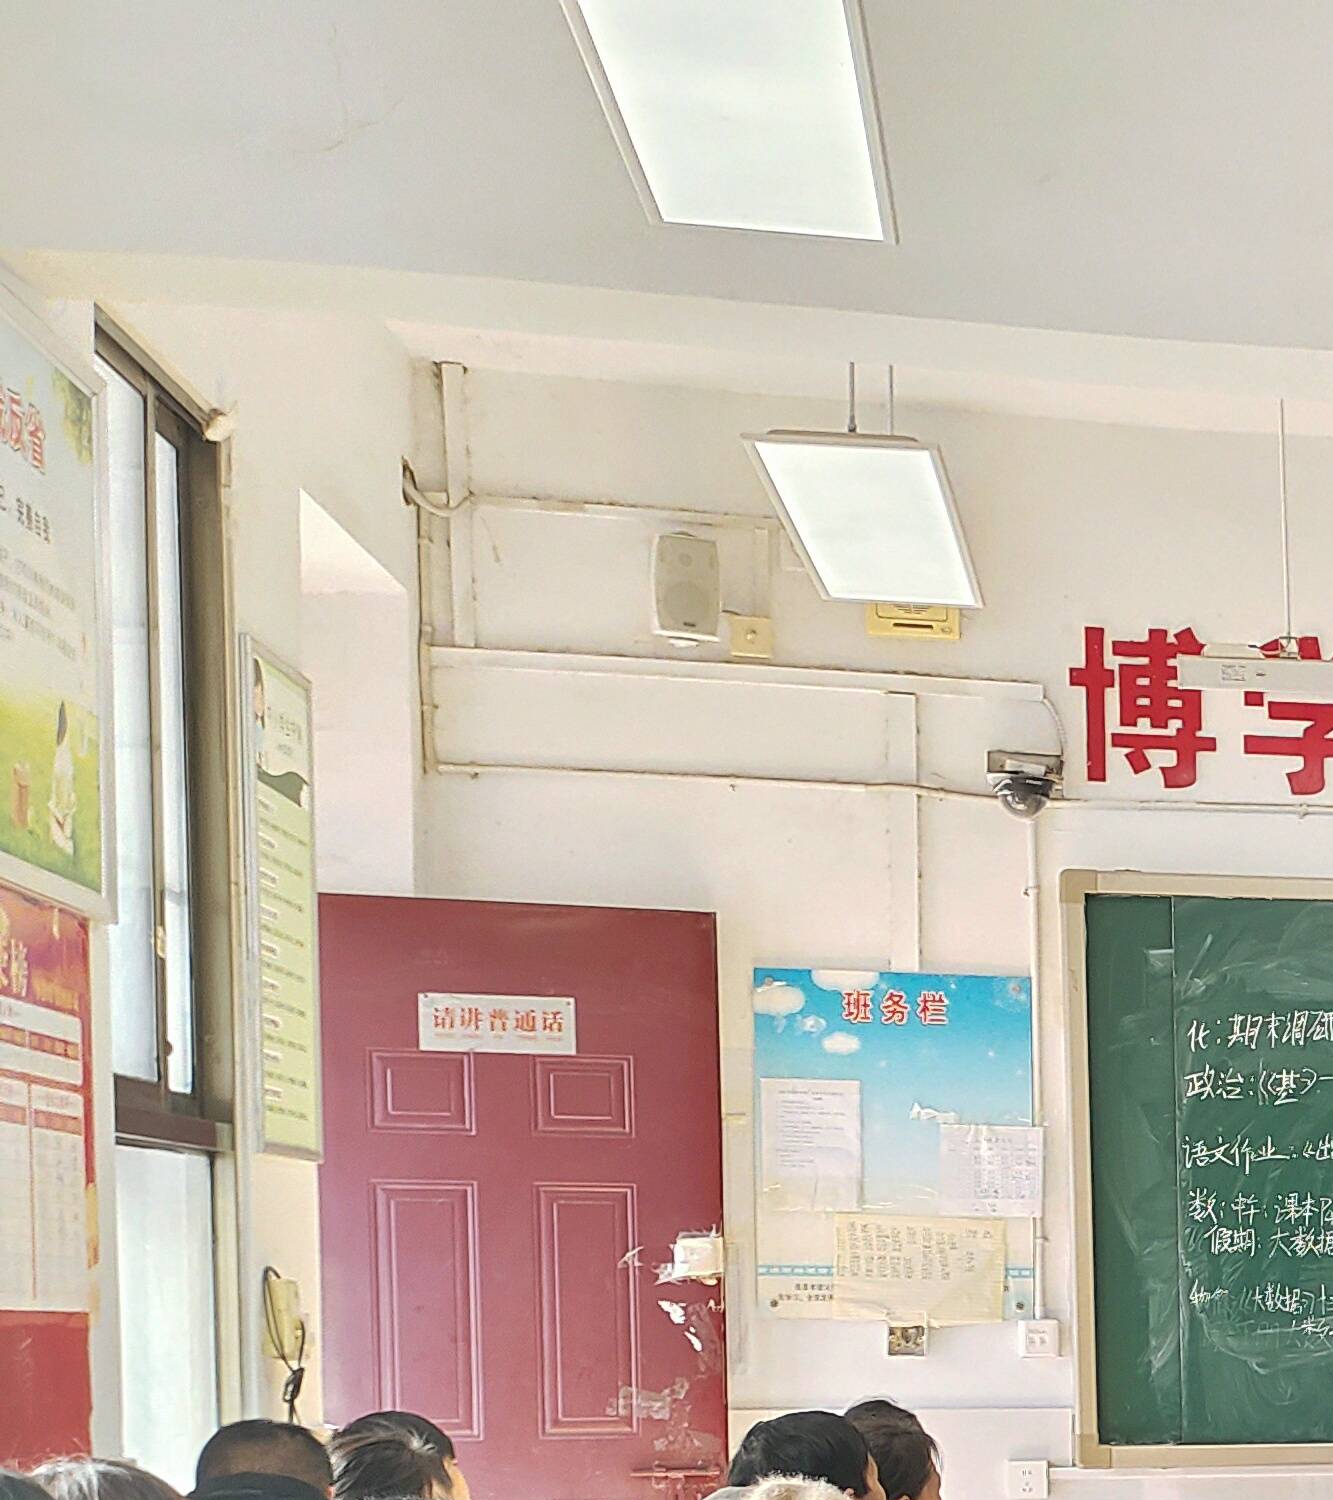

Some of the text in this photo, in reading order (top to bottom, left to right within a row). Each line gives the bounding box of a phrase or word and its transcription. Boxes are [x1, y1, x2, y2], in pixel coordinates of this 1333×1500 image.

[433, 1007, 563, 1032] 请讲普通话
[842, 989, 948, 1024] 班务栏
